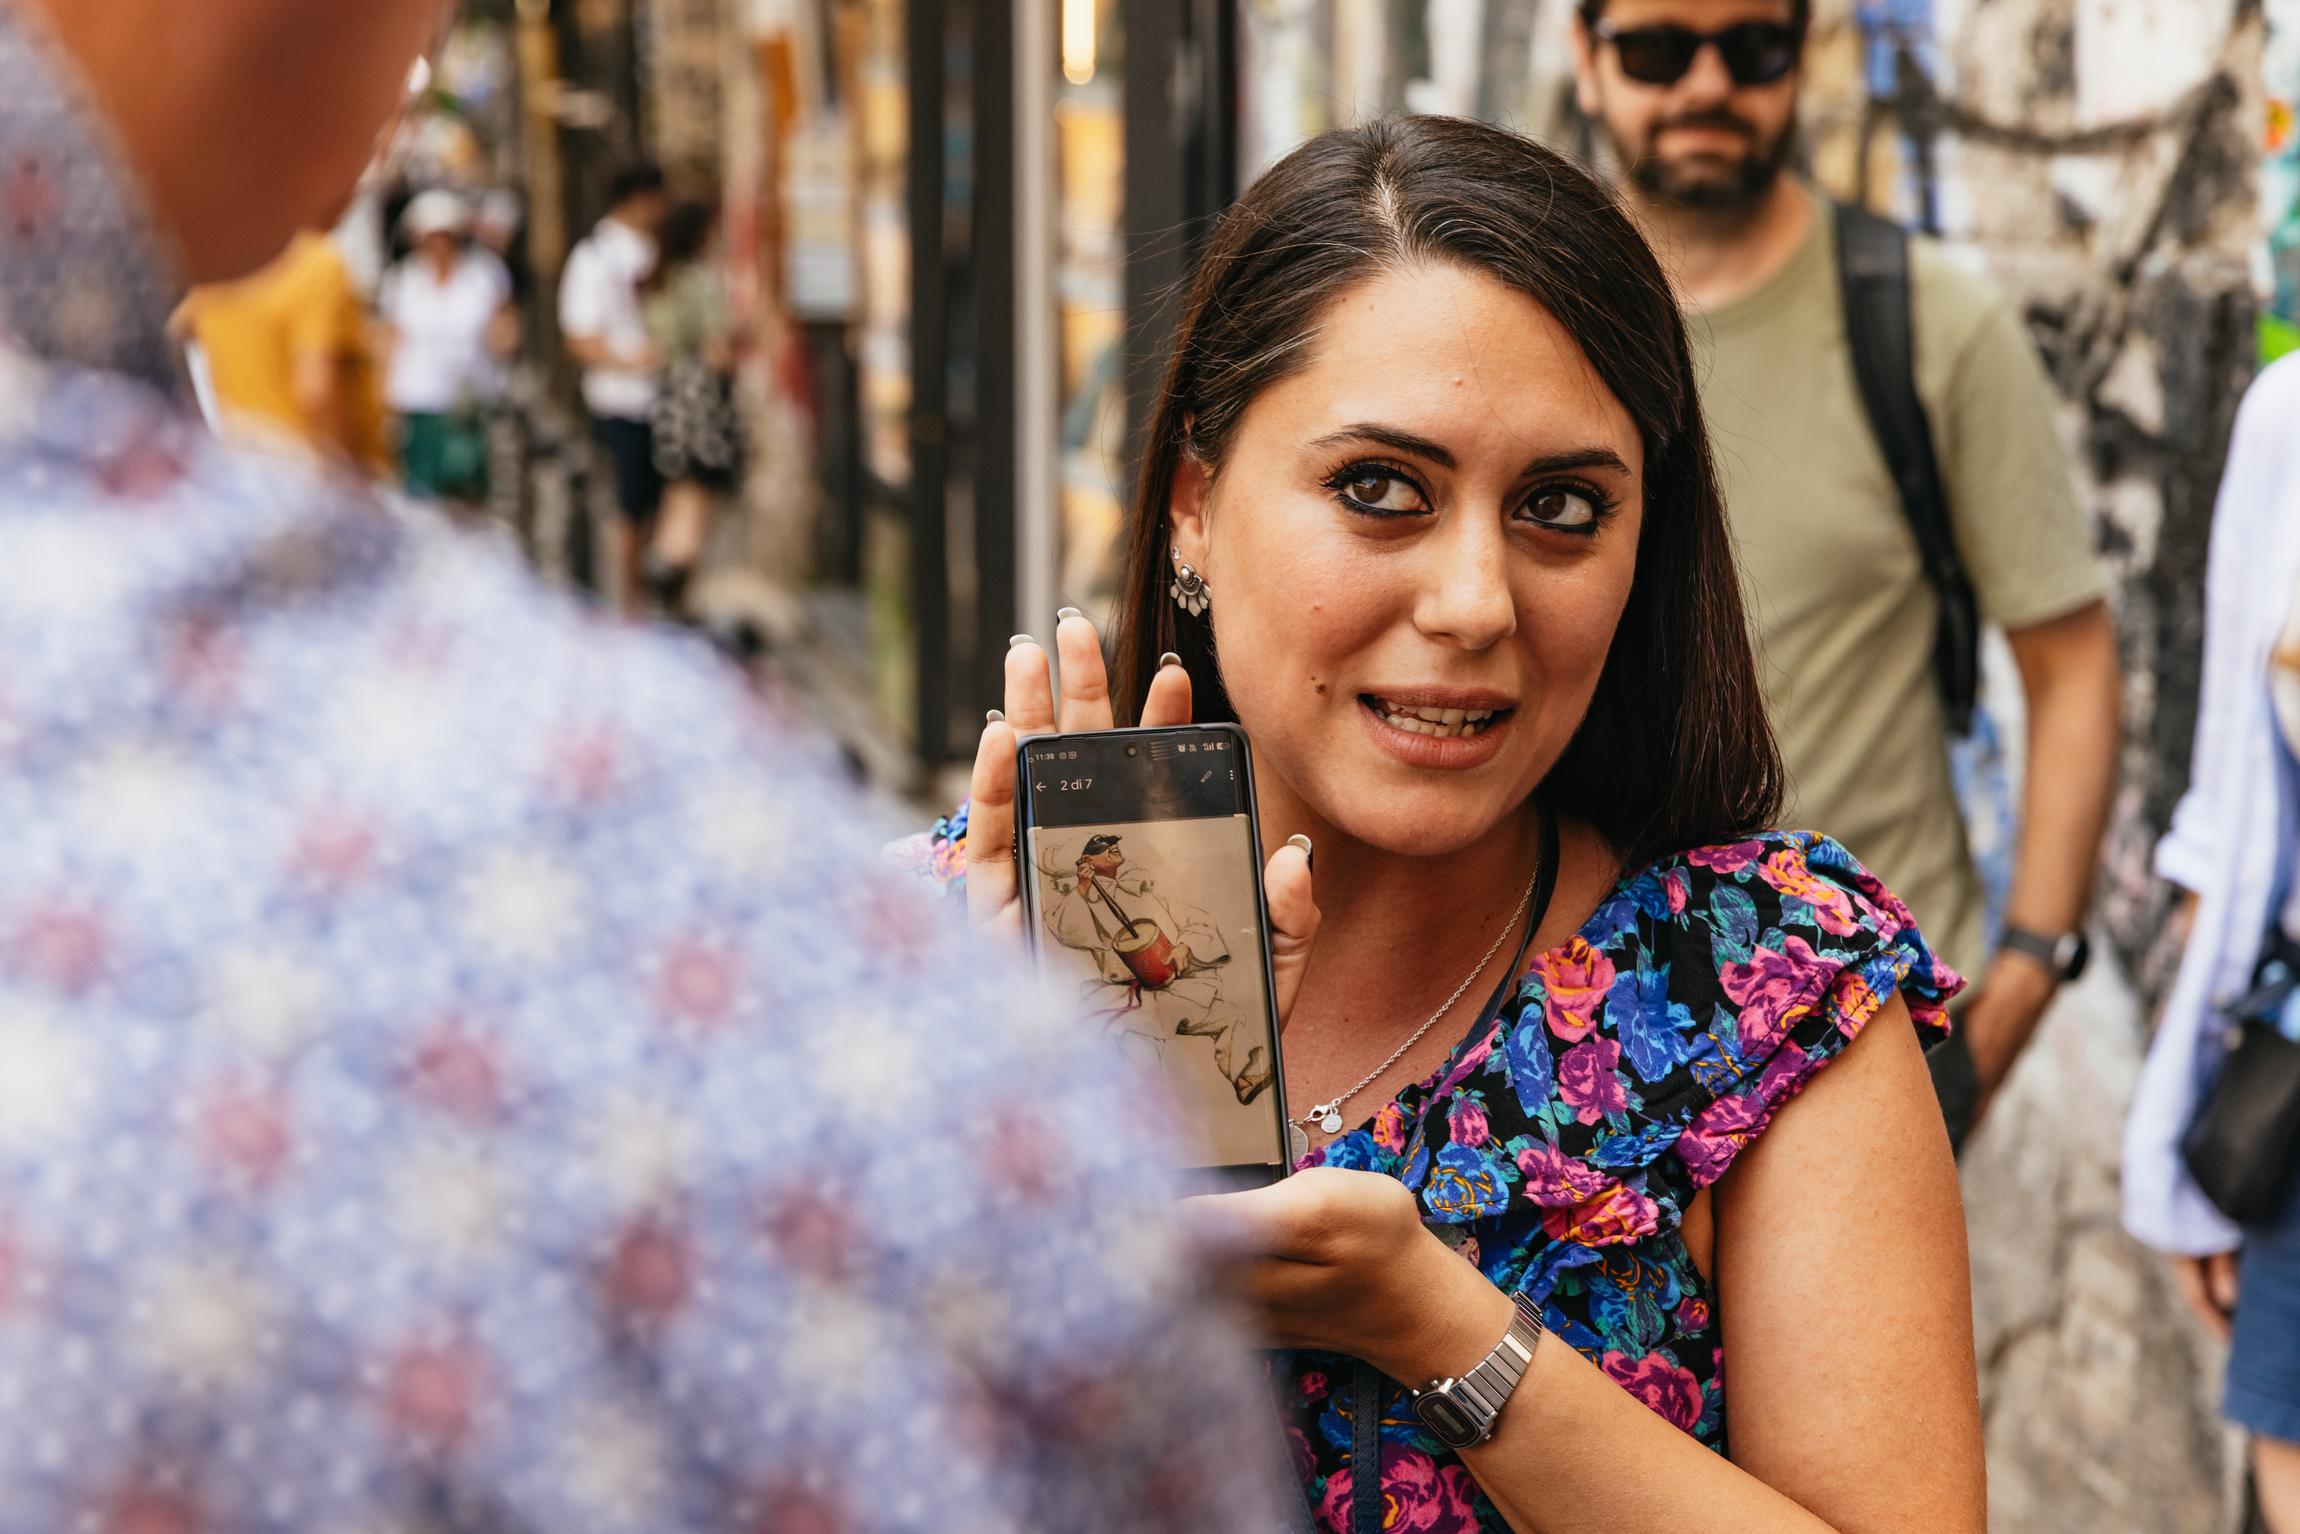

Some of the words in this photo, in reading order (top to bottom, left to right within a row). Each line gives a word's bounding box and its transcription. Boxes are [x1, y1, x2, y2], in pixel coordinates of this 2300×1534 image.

[1060, 780, 1068, 791] 2
[1071, 779, 1082, 790] di
[1085, 779, 1092, 789] 7
